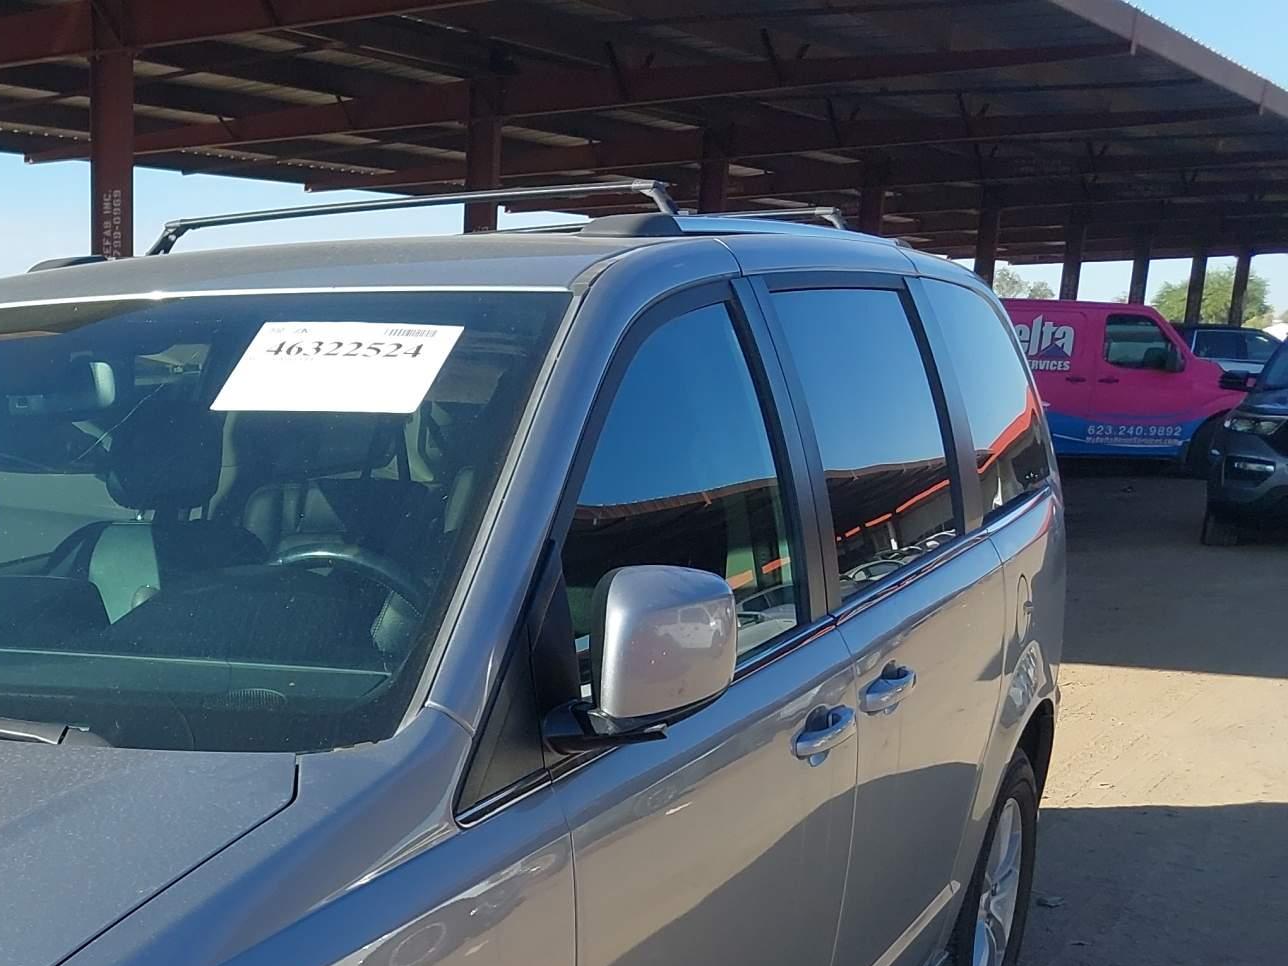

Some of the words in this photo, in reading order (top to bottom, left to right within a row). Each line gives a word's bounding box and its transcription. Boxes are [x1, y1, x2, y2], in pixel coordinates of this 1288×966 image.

[1014, 314, 1074, 357] elta
[266, 340, 425, 359] 46322524
[1087, 425, 1183, 437] 623.240.9892
